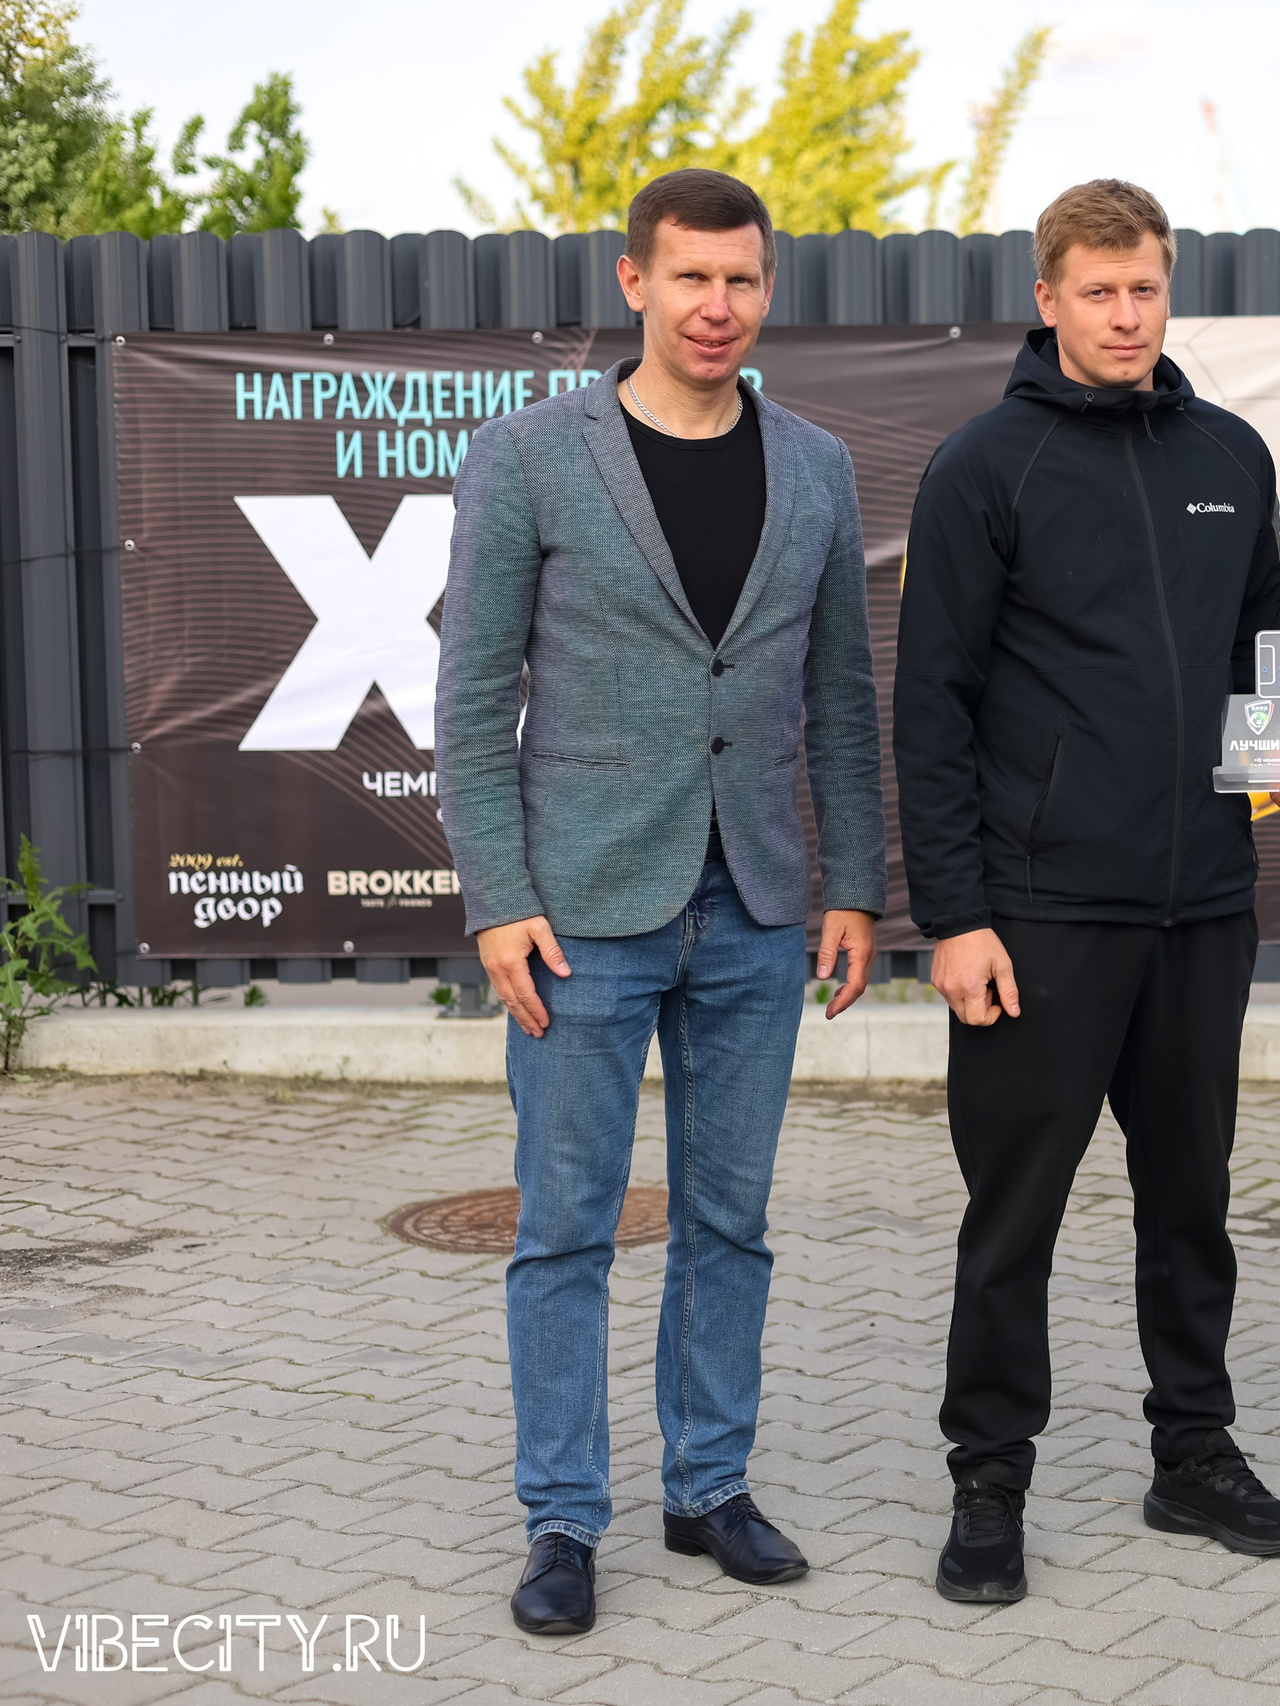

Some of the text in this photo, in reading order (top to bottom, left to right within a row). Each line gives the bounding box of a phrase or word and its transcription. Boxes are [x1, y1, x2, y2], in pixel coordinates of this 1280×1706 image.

[235, 370, 535, 427] НАГРАЖДЕНИЕ
[335, 428, 476, 479] И НОМ
[1196, 502, 1236, 513] Columbia
[168, 853, 213, 871] 2009
